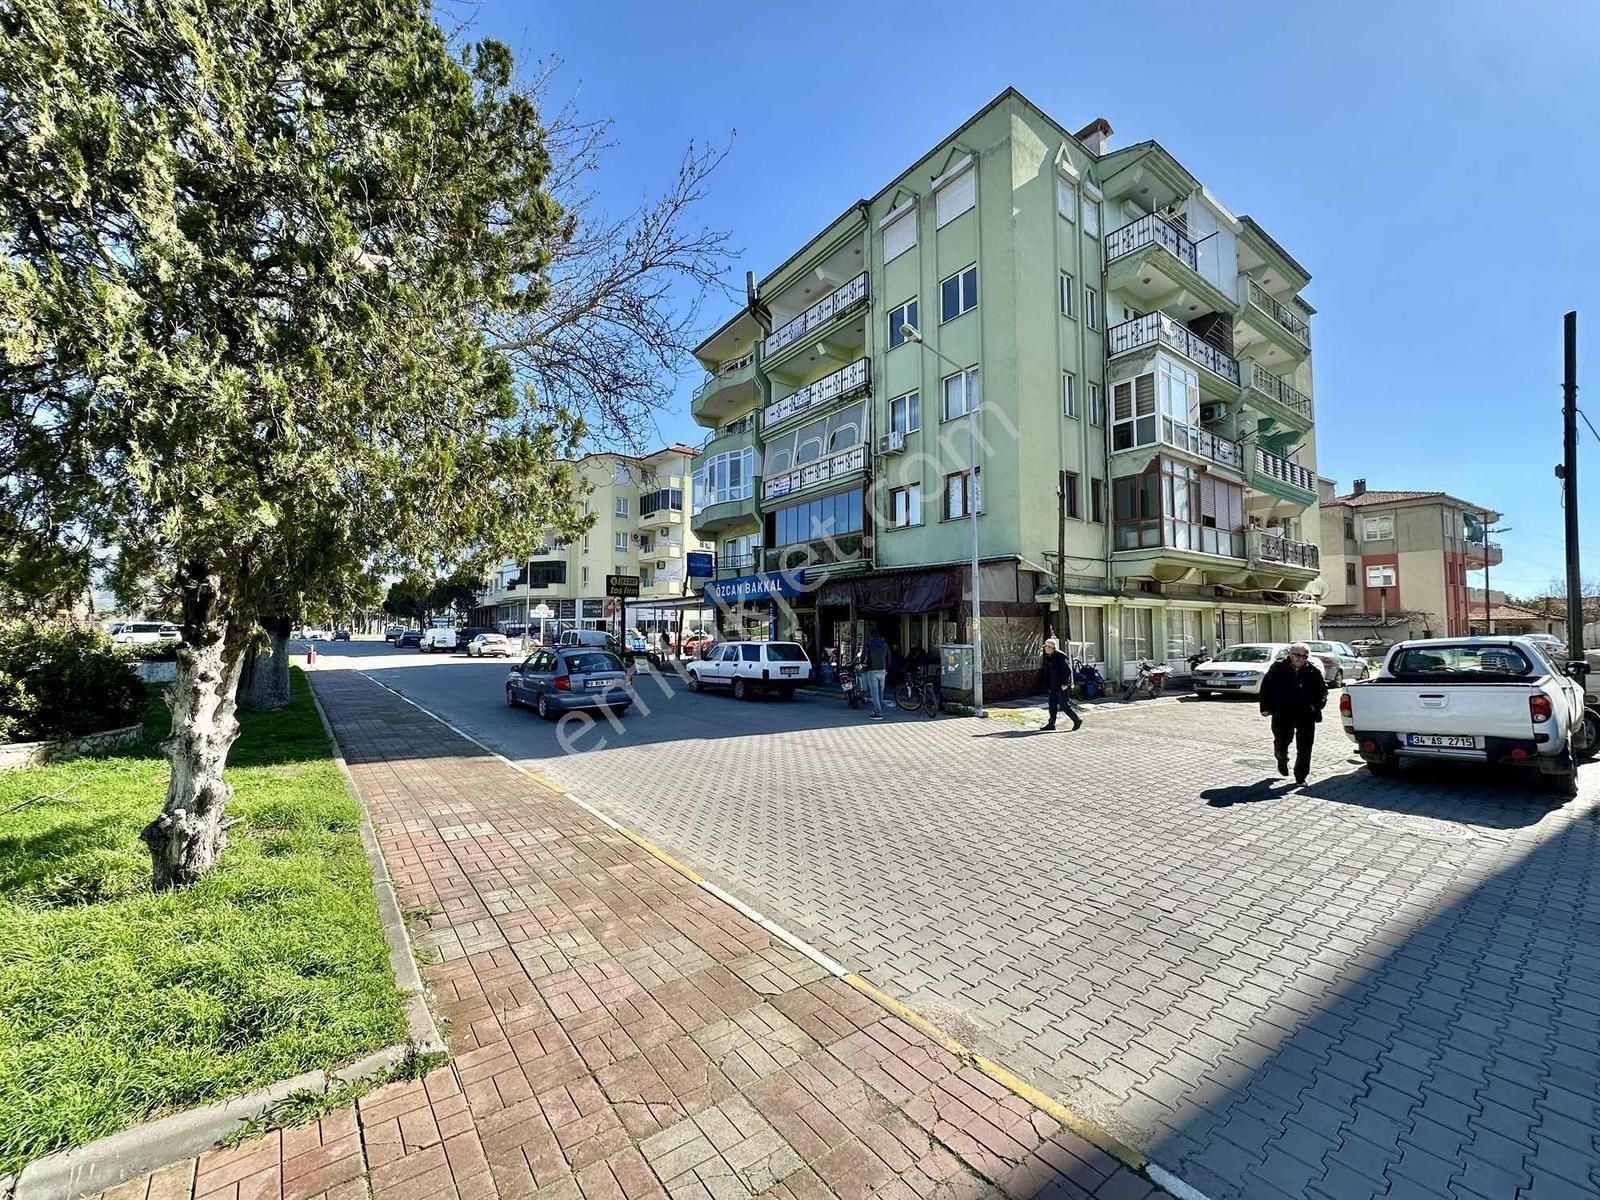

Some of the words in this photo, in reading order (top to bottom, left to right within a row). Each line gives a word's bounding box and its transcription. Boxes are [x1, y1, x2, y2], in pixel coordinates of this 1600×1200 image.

[715, 583, 742, 597] ÖZCAN
[745, 579, 782, 594] BAKKAL
[1414, 736, 1425, 745] 34
[1431, 737, 1443, 745] AS
[1448, 737, 1472, 747] 2715
